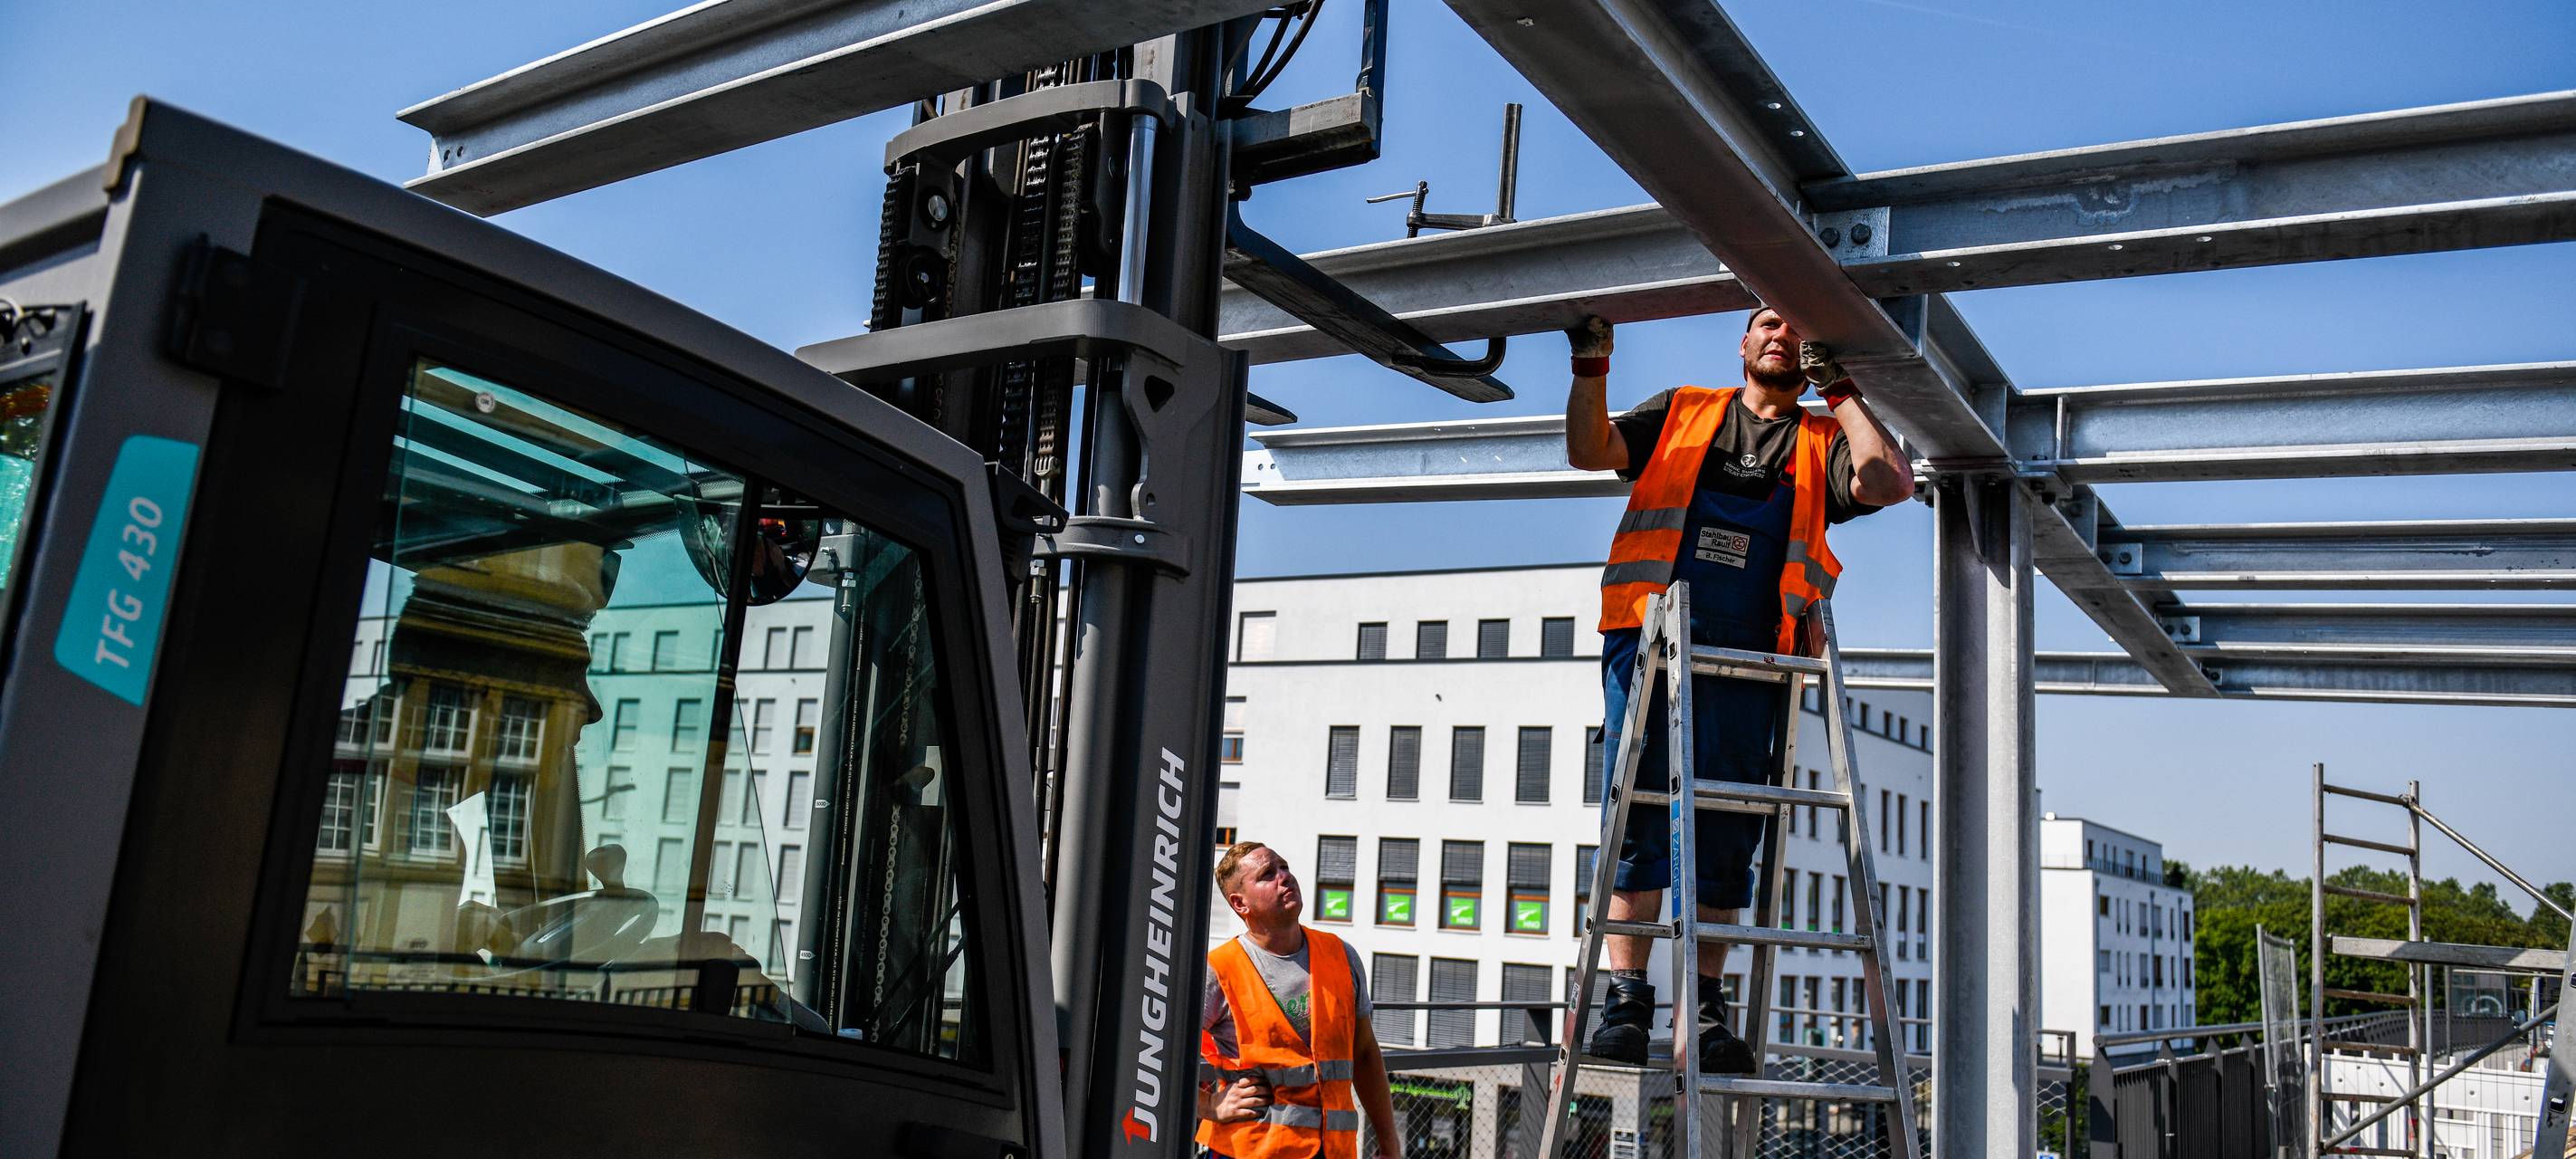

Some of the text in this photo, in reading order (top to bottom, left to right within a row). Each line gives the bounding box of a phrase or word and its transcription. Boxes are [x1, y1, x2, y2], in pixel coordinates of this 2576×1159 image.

[1701, 530, 1732, 541] Stahlbau
[1713, 553, 1735, 564] Fischer
[94, 496, 164, 668] TFG 430
[1672, 836, 1681, 899] ZARGES
[1132, 746, 1186, 1144] JUNGHEINRICH
